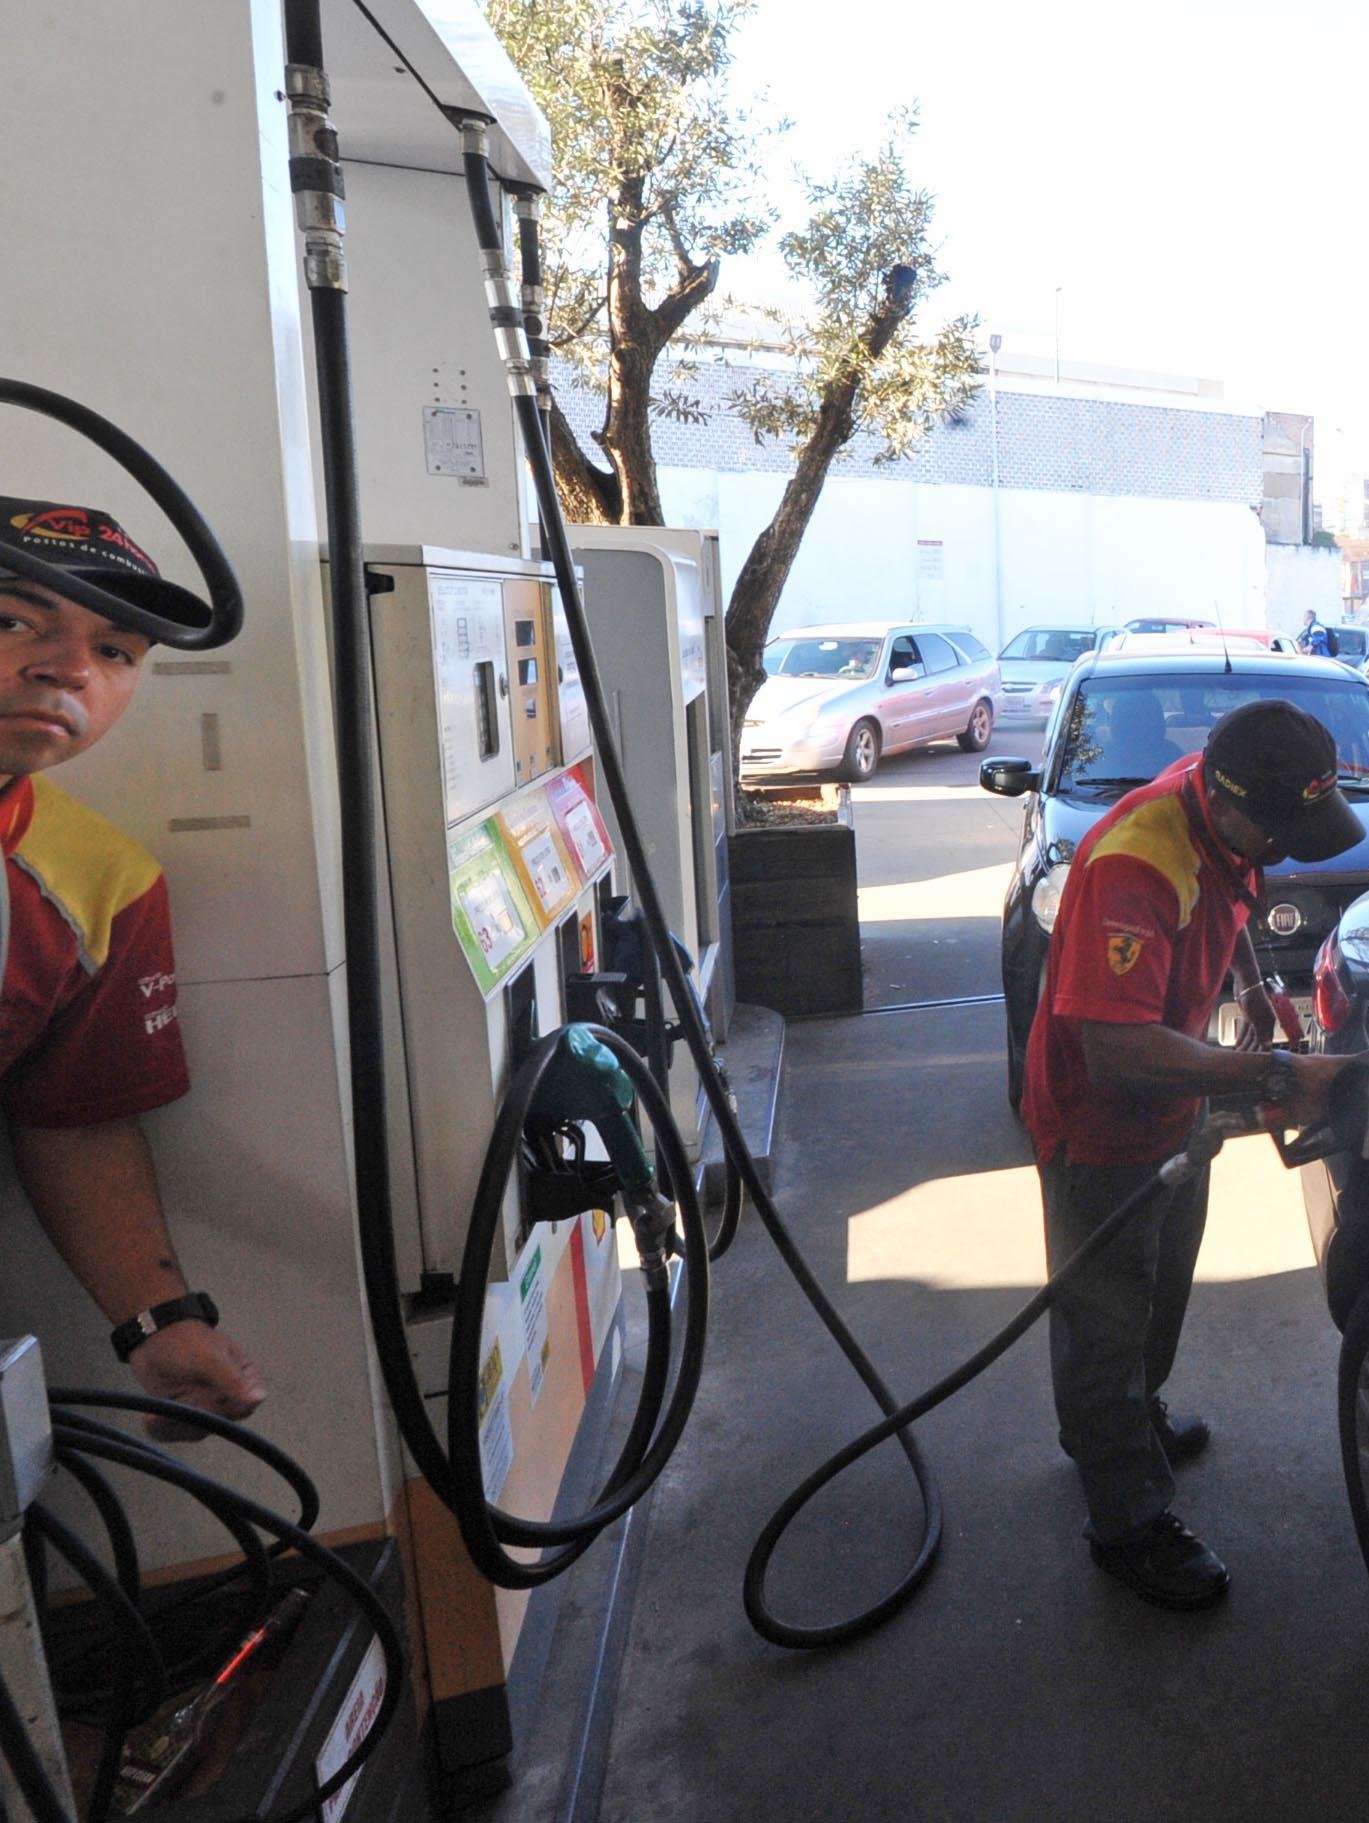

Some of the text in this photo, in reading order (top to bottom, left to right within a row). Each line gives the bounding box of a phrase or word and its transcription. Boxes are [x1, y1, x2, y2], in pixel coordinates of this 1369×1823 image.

[22, 535, 75, 549] Postos
[80, 543, 97, 553] de
[1276, 912, 1295, 928] FIAT
